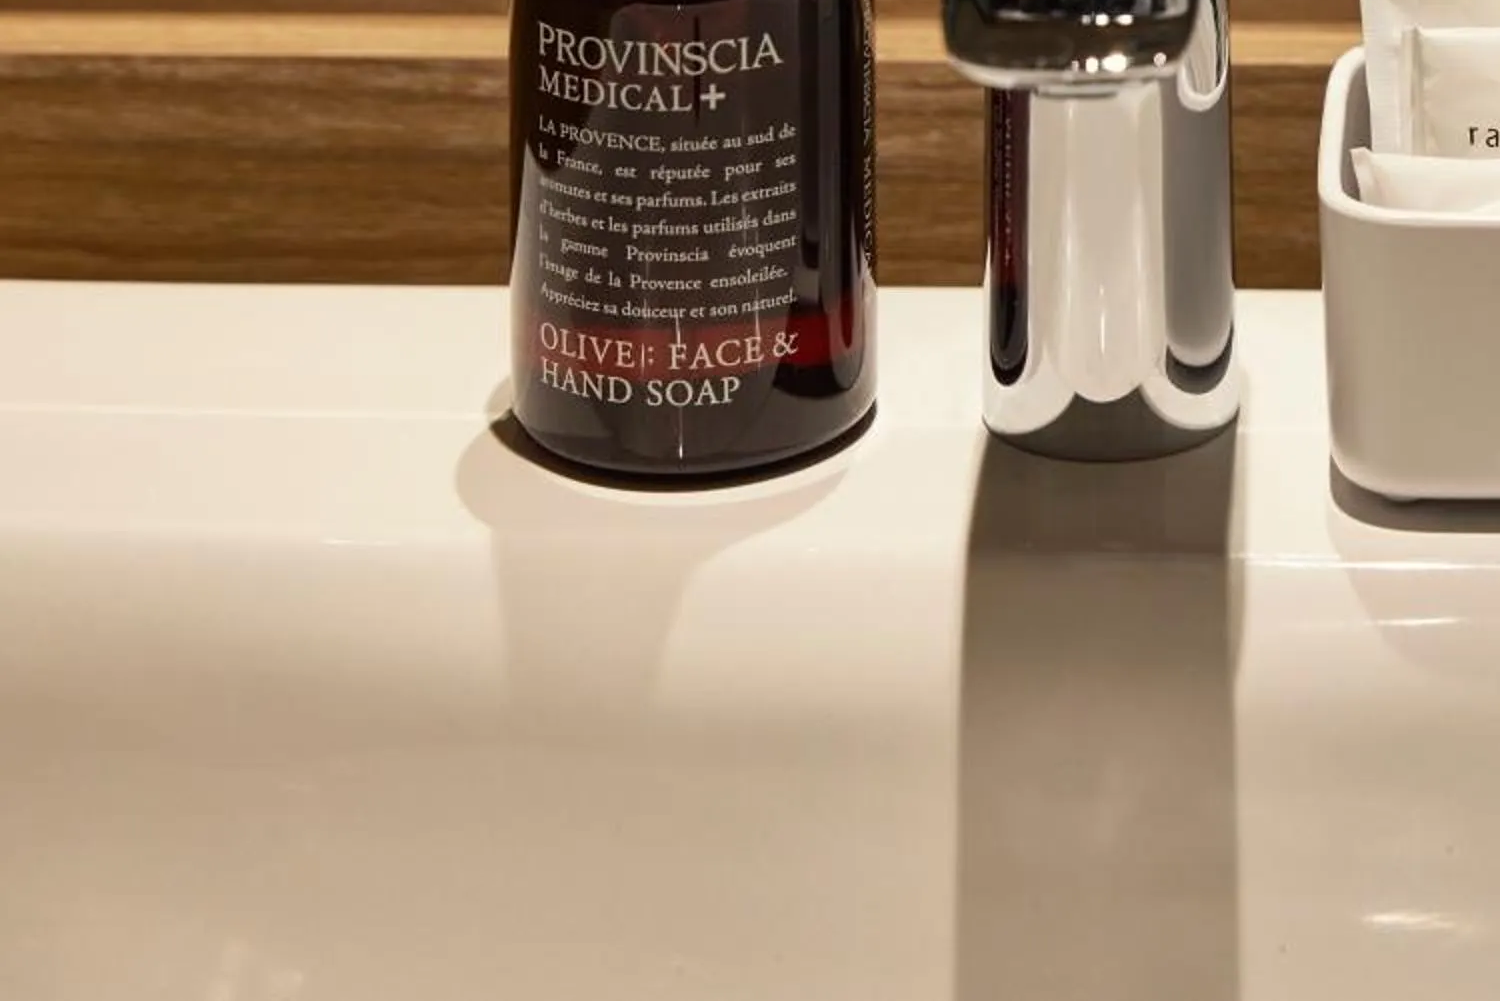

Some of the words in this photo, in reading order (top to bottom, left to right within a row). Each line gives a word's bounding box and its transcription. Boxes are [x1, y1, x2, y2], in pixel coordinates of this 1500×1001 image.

[538, 20, 784, 77] PROVINSCIA
[538, 64, 693, 112] MEDICAL
[539, 114, 557, 136] LA
[559, 122, 666, 152] PROVENCE,
[670, 136, 718, 152] située
[722, 136, 742, 149] au
[747, 125, 774, 145] sud
[778, 122, 797, 140] de
[614, 165, 638, 179] est
[650, 163, 712, 185] réputée
[724, 161, 763, 182] pour
[774, 153, 797, 168] ses
[593, 191, 609, 204] et
[609, 193, 634, 207] ses
[635, 190, 708, 212] parfums.
[710, 190, 739, 207] Les
[740, 180, 797, 203] extraits
[590, 218, 606, 232] et
[608, 215, 629, 233] les
[631, 219, 700, 241] parfums
[702, 214, 759, 235] utilisés
[761, 208, 798, 227] dans
[626, 244, 710, 263] Provinscia
[727, 235, 797, 259] évoquent
[584, 266, 602, 285] de
[608, 270, 622, 288] la
[629, 273, 703, 291] Provence
[602, 302, 619, 315] sa
[688, 305, 706, 319] et
[708, 303, 738, 317] son
[668, 336, 765, 371] FACE
[772, 330, 799, 358] &
[539, 356, 633, 404] HAND
[646, 375, 741, 408] SOAP
